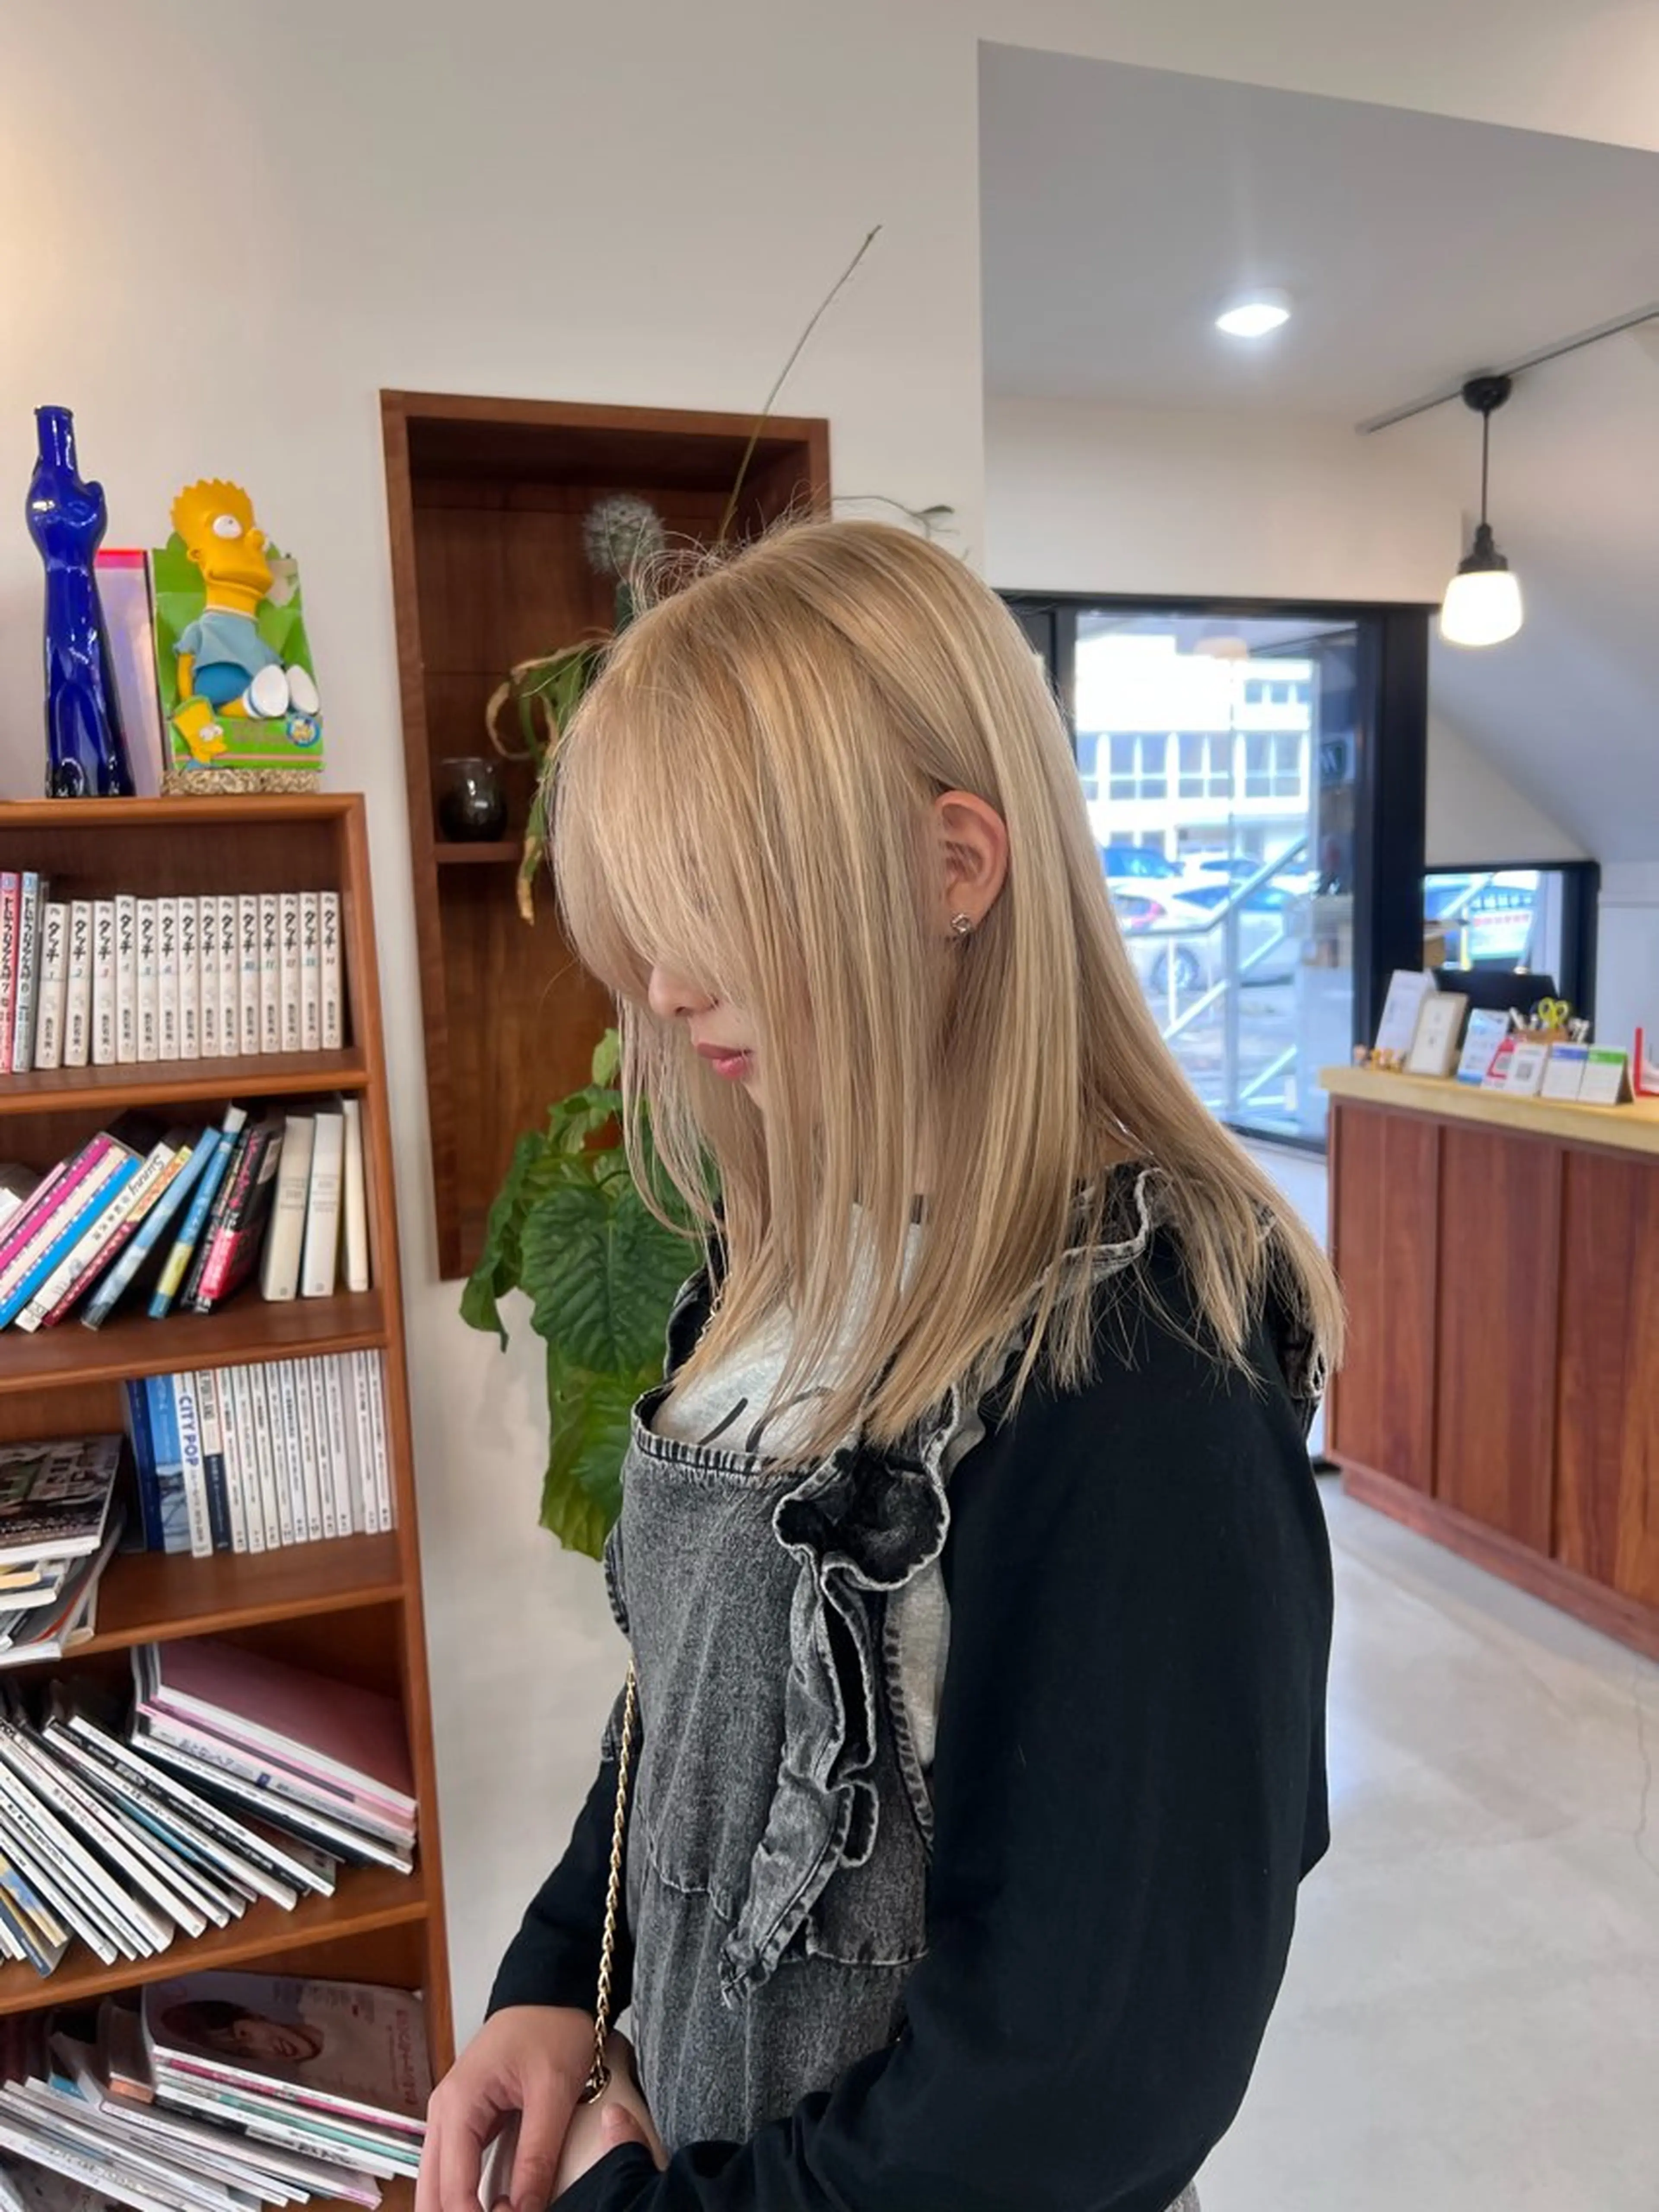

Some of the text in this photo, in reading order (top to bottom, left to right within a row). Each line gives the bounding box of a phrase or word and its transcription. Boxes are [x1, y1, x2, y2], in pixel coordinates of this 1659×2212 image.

[128, 1154, 165, 1195] Sunny
[179, 1395, 197, 1431] CITY
[183, 1434, 199, 1467] POP
